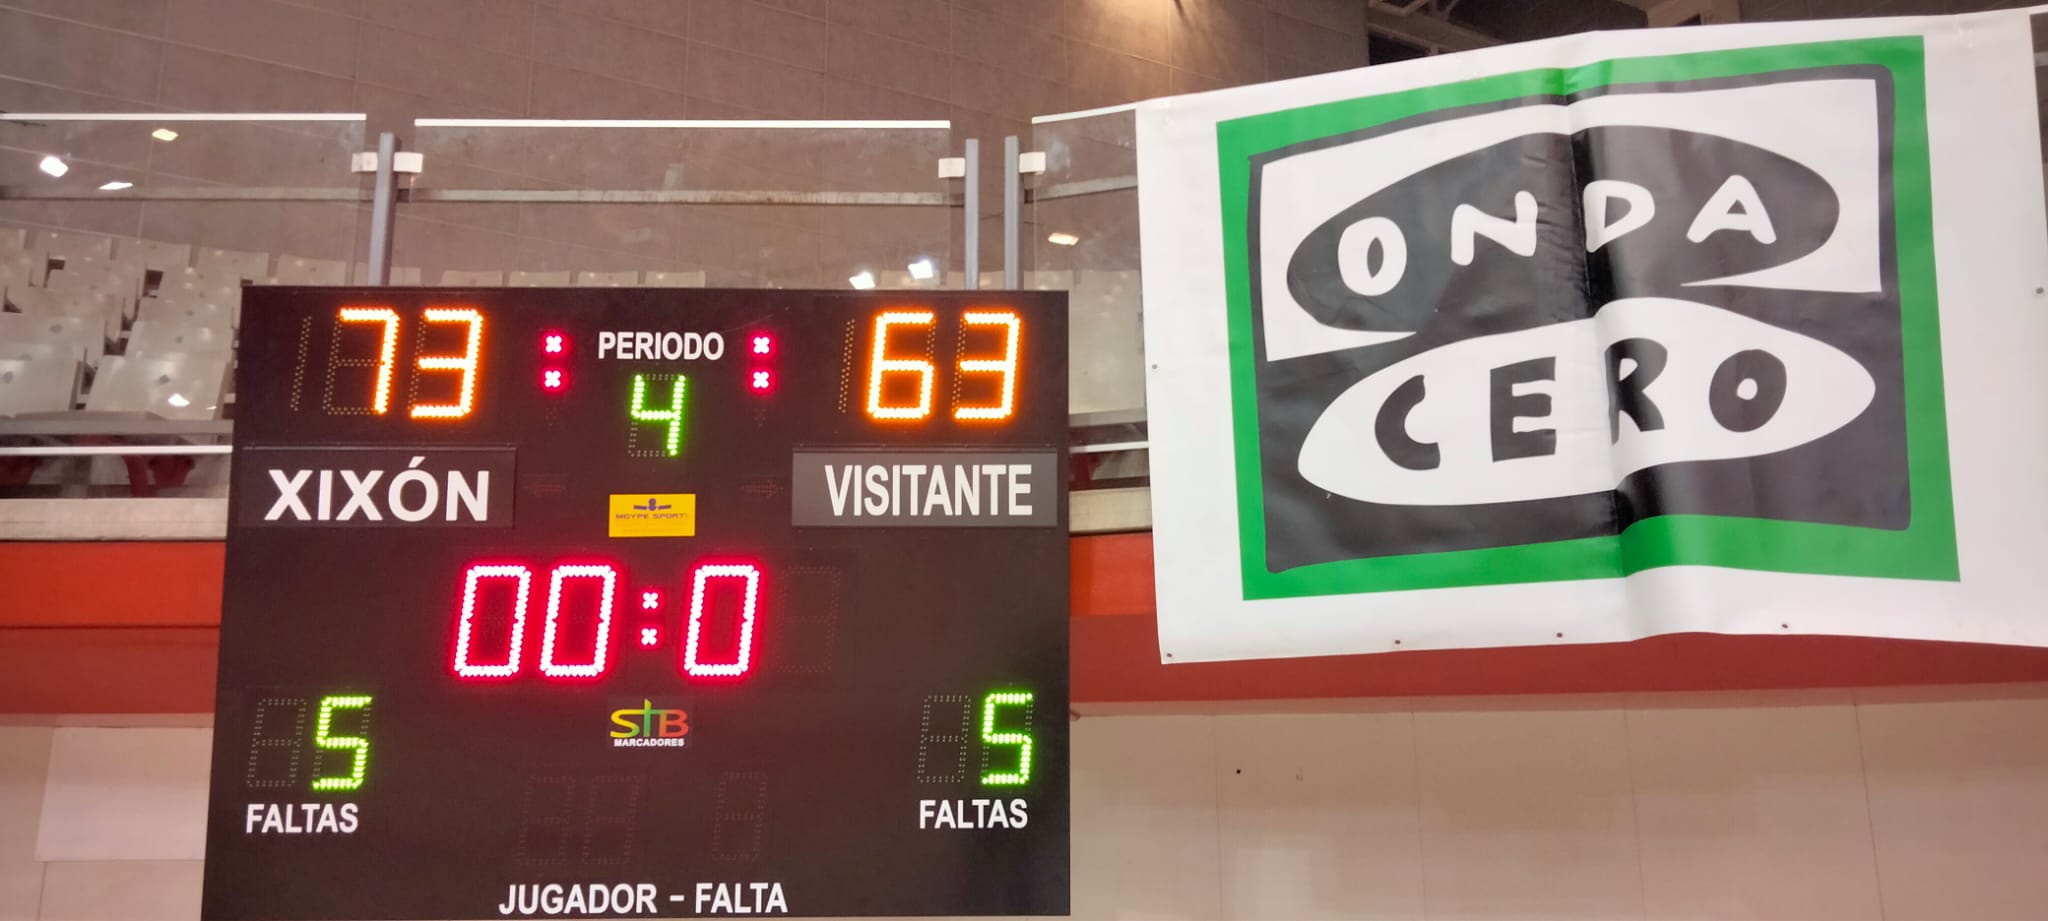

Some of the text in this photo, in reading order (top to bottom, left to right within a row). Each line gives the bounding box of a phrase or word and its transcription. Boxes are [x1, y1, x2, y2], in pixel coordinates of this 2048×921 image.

[1338, 174, 1776, 296] ONDA
[338, 307, 483, 418] 73
[597, 330, 725, 361] PERIODO
[867, 311, 1020, 419] 63
[629, 373, 686, 456] 4
[1374, 337, 1788, 472] CERO
[263, 456, 490, 522] XIXÓN
[824, 464, 1033, 517] VISITANTE
[312, 695, 372, 790] 5
[613, 738, 685, 747] MARCADORES
[981, 692, 1033, 785] 5
[245, 802, 359, 834] FALTAS
[919, 798, 1029, 829] FALTAS
[498, 883, 658, 914] JUGADOR
[695, 882, 789, 914] FALTA
